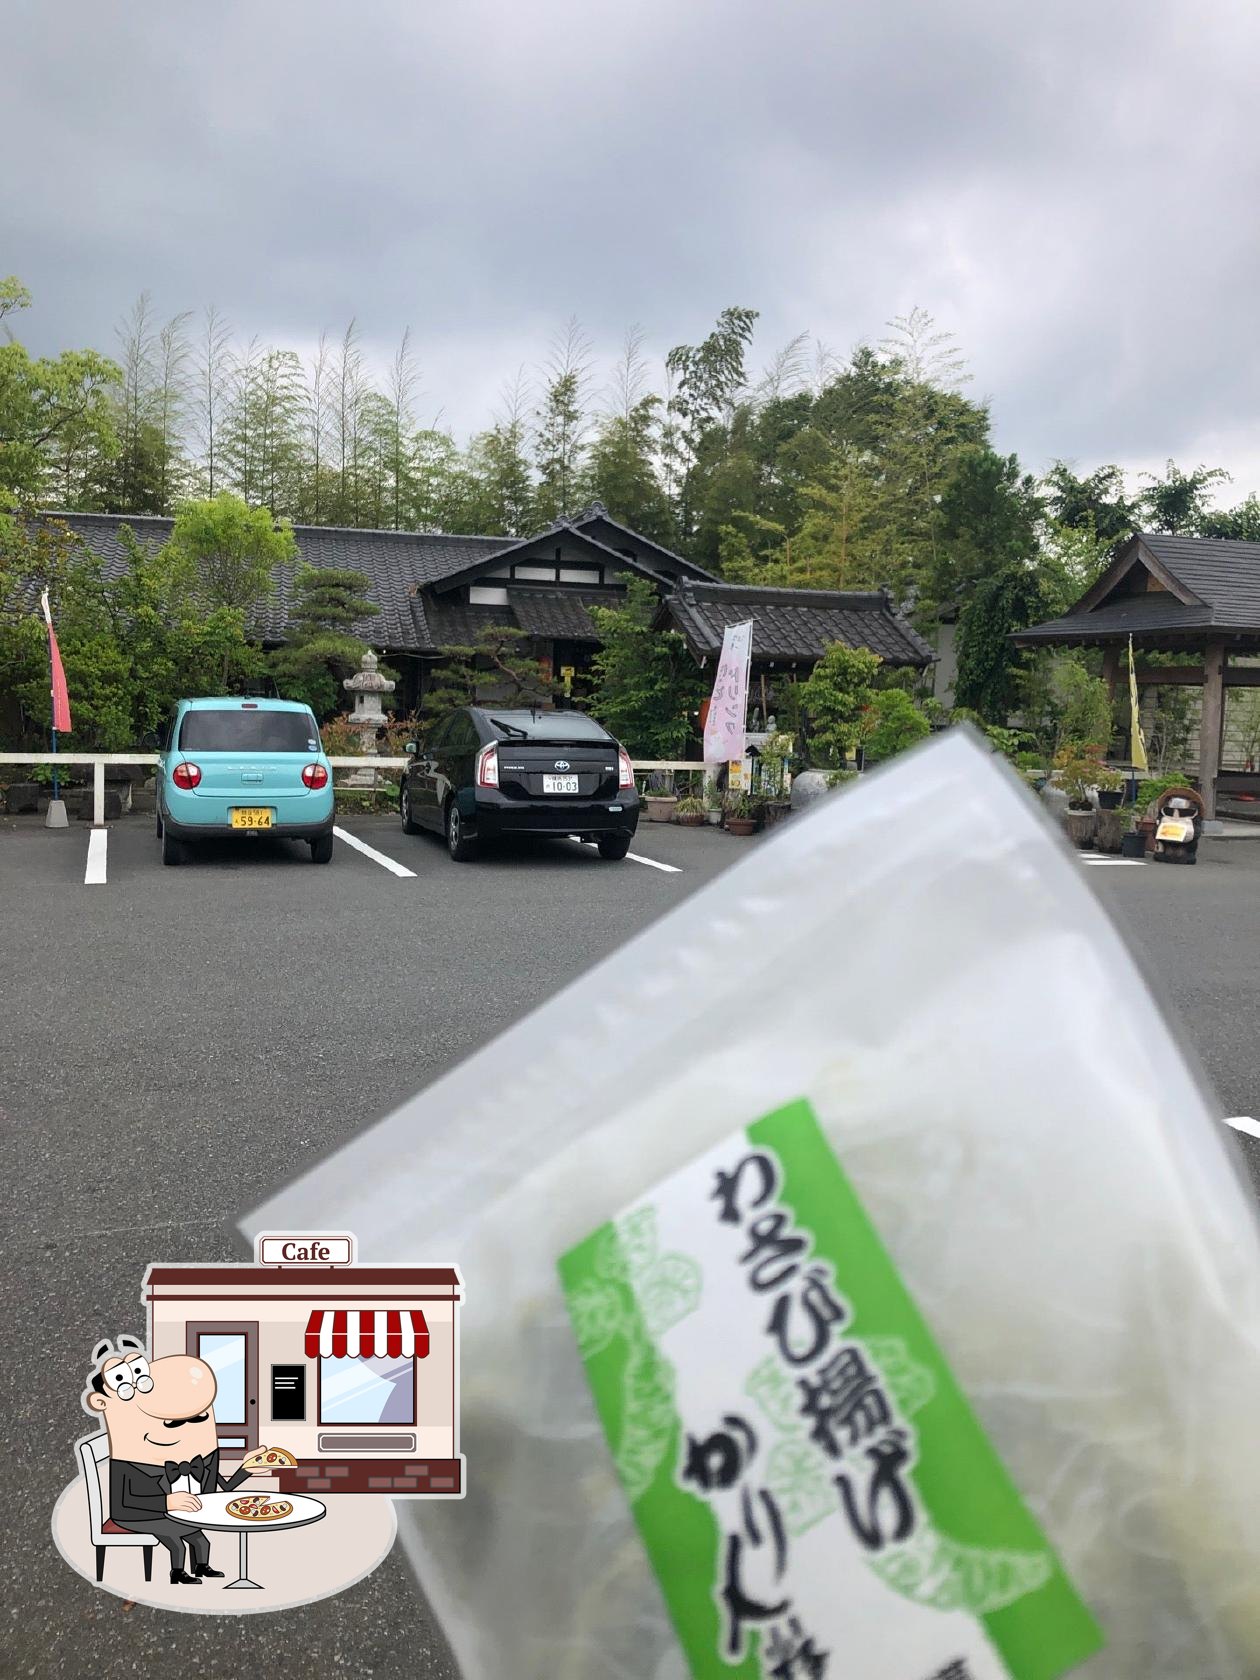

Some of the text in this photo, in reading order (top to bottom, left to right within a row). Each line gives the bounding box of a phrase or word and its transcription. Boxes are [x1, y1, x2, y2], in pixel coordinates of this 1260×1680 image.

[710, 1153, 915, 1551] わさび揚げ
